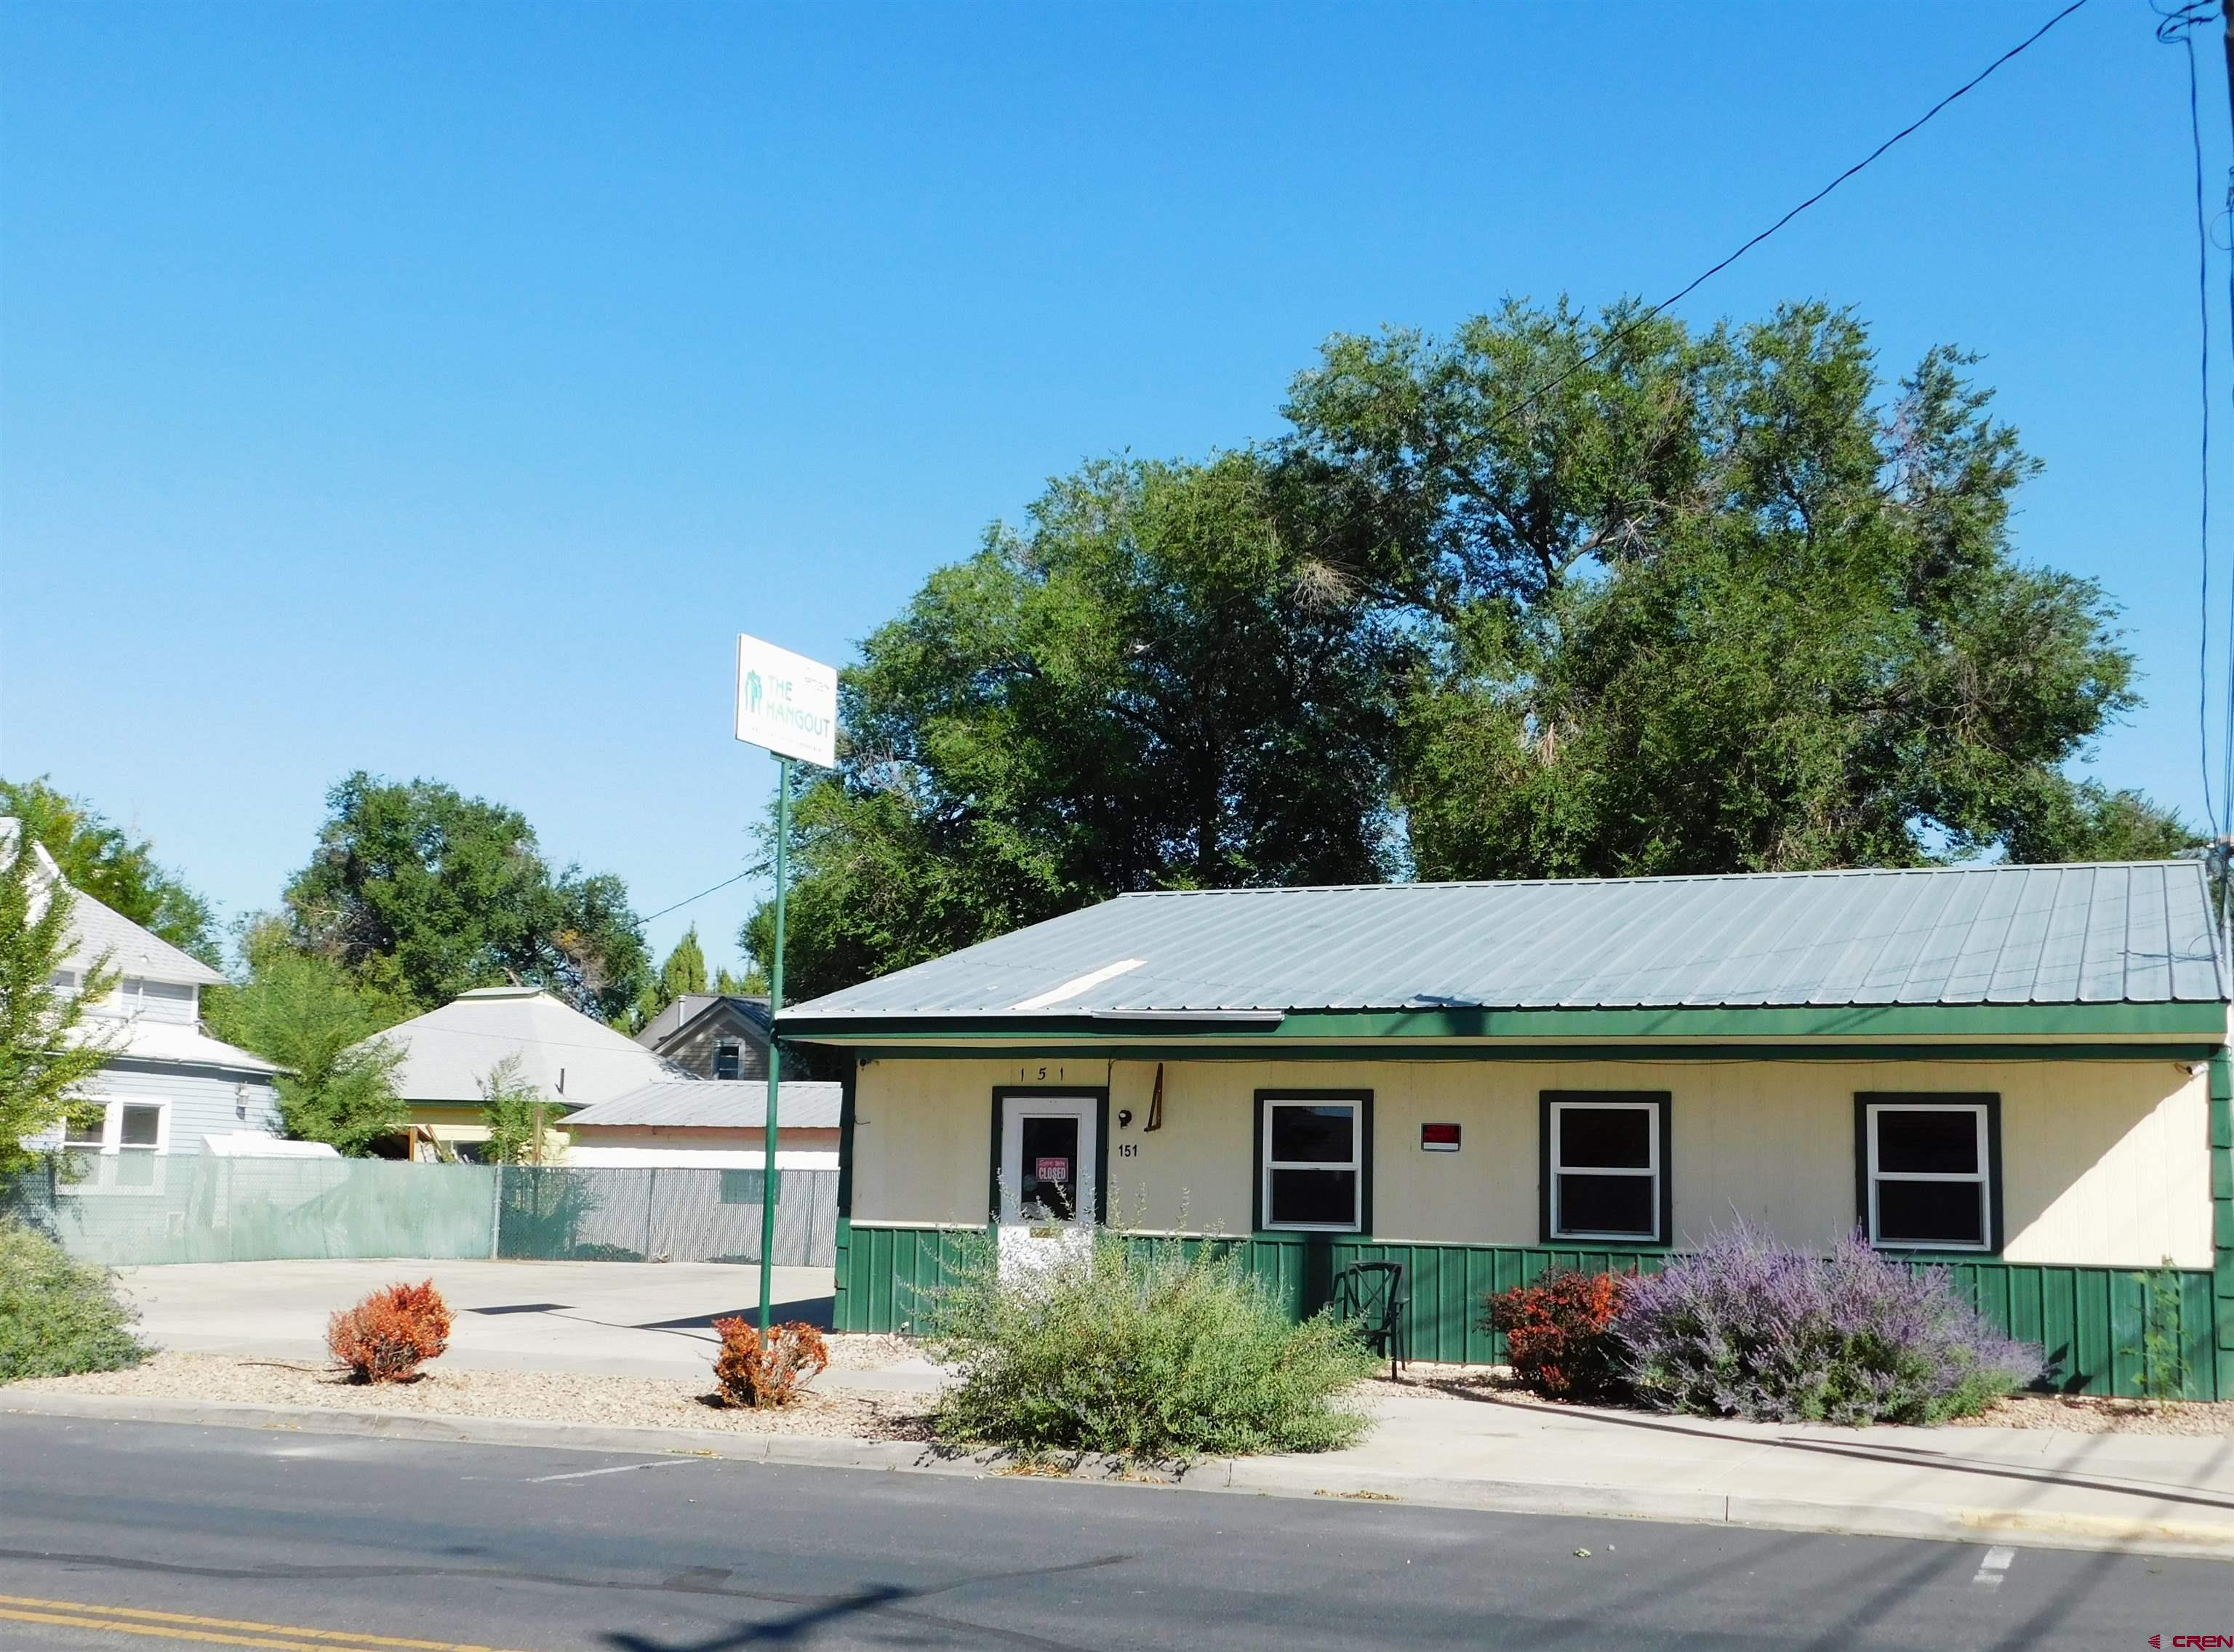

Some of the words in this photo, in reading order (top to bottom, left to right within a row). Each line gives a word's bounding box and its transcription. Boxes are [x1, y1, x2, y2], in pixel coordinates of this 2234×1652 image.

[767, 675, 793, 702] THE
[766, 699, 830, 738] HANGOUT
[1118, 1144, 1138, 1158] 151
[1038, 1167, 1066, 1179] CLOSED
